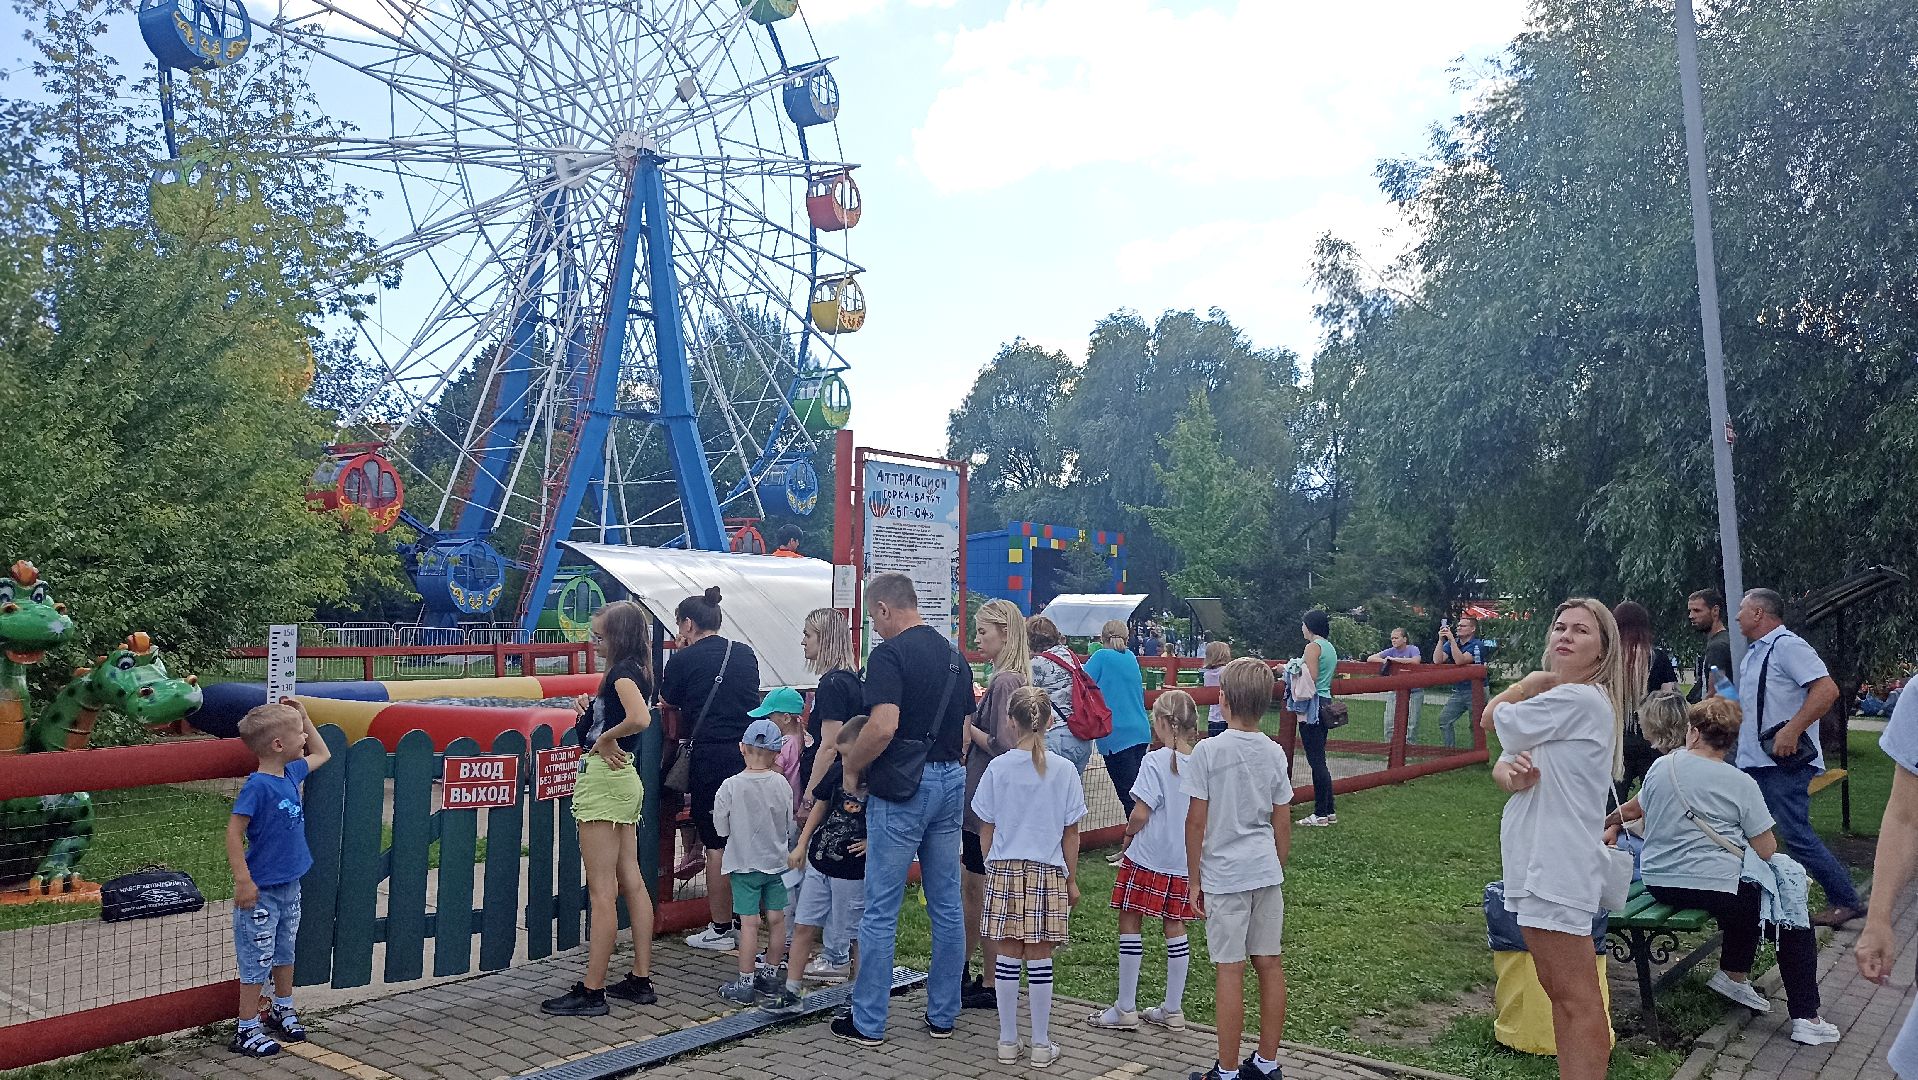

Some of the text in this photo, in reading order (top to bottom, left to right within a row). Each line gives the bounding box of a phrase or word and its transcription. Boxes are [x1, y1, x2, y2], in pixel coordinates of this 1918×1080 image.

[283, 629, 295, 637] 150
[283, 656, 294, 664] 140
[551, 750, 576, 762] ВХОД НА
[459, 761, 505, 780] ВХОД
[539, 775, 552, 786] БЕЗ
[449, 785, 510, 804] ВЫХОД
[545, 782, 574, 796] ЗАПРЕЩЕ
